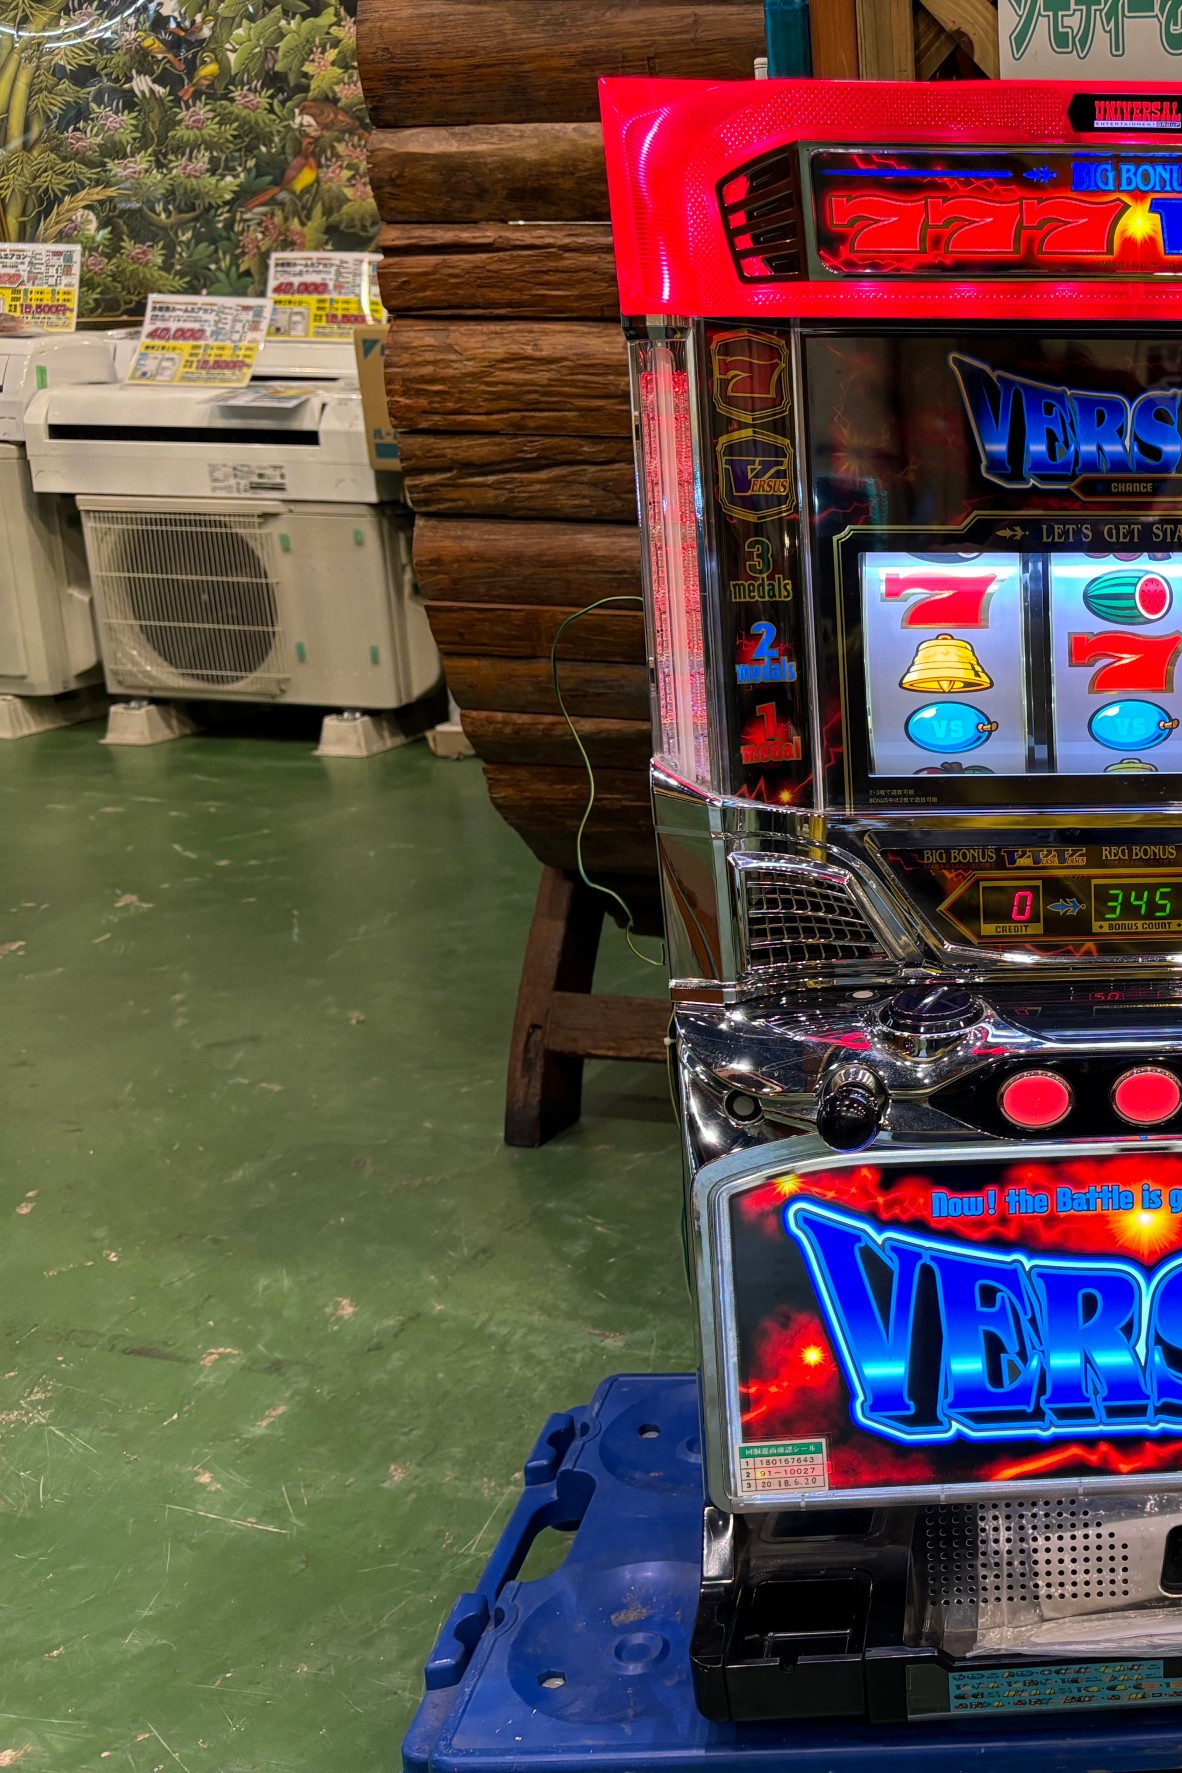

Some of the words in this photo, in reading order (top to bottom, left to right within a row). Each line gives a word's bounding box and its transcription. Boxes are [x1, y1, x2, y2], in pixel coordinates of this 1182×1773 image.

[1094, 100, 1181, 122] UNIVERSAL
[1071, 162, 1116, 192] BIG
[1110, 482, 1153, 493] CHANCE
[1041, 524, 1093, 543] LET'S
[1103, 524, 1142, 543] GET
[745, 537, 773, 577] 3
[730, 574, 793, 602] medals
[751, 621, 779, 659] 2
[735, 656, 798, 685] medals
[756, 702, 779, 742] 1
[931, 719, 964, 738] VS
[1115, 717, 1147, 736] VS
[740, 737, 802, 765] medal
[924, 849, 947, 863] BIG
[951, 848, 996, 863] BONUS
[1101, 846, 1128, 860] REG
[1132, 845, 1177, 859] BONUS
[1011, 891, 1032, 921] 0
[1104, 887, 1172, 919] 345
[994, 925, 1030, 934] CREDIT
[1108, 922, 1139, 931] BONUS
[1141, 921, 1172, 930] COUNT
[1005, 1188, 1048, 1215] the
[1056, 1184, 1134, 1213] Battle
[1141, 1183, 1162, 1210] is
[760, 1456, 815, 1466] 180167643
[760, 1467, 815, 1478] 91-10027
[761, 1480, 772, 1488] 20
